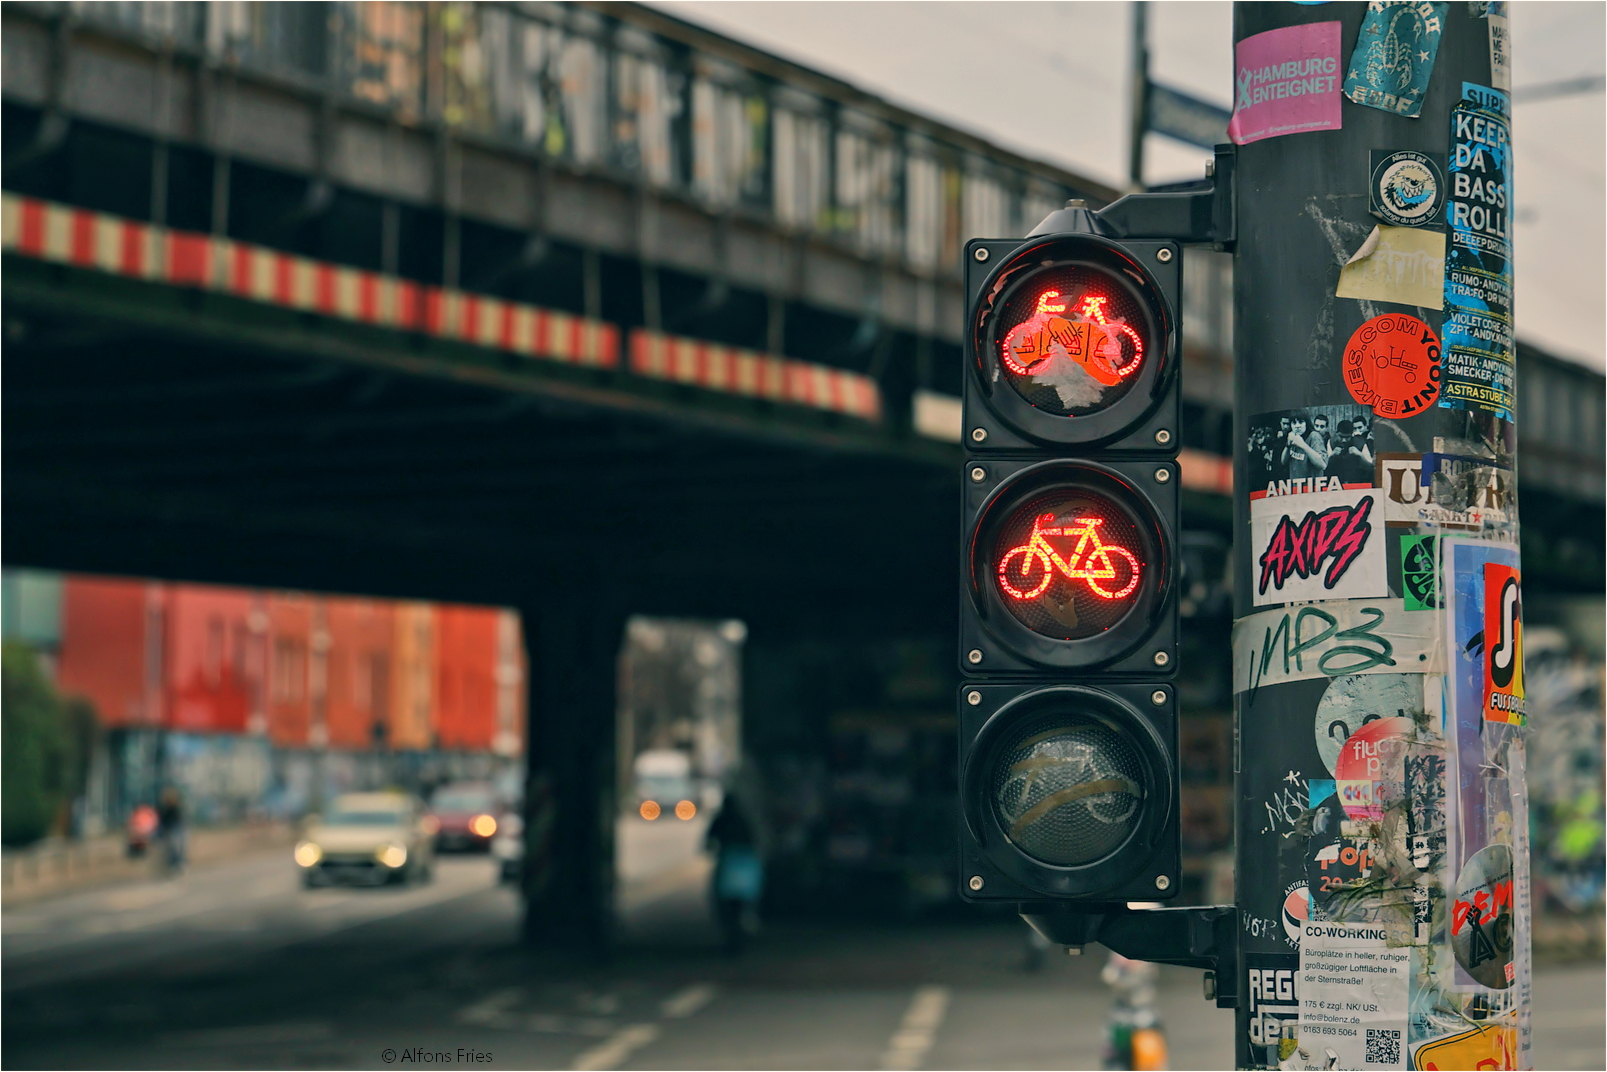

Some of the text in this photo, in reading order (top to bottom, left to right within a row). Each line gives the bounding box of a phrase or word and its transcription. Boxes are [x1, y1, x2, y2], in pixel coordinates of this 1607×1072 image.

[1253, 57, 1337, 86] HAMBURG
[1253, 76, 1337, 104] ENTEIGNET
[1456, 114, 1506, 149] KEEP
[1392, 152, 1427, 164] Alles ist gut
[1456, 142, 1486, 172] DA
[1454, 172, 1506, 208] BASS
[1380, 204, 1400, 221] solange
[1410, 216, 1426, 224] queer
[1452, 272, 1480, 286] RUMO
[1451, 312, 1482, 328] VIOLET
[1482, 319, 1500, 333] CORE
[1450, 324, 1470, 336] ZPT
[1448, 354, 1478, 368] MATIK
[1448, 364, 1492, 382] SMECKER
[1446, 384, 1479, 398] ASTRA
[1480, 389, 1503, 403] STUBE
[1266, 476, 1343, 498] ANTIFA
[1306, 926, 1386, 940] CO-WORKING
[1306, 948, 1344, 958] Büroplätze
[1354, 952, 1378, 960] heller,
[1380, 954, 1410, 962] ruhiger,
[1304, 962, 1348, 972] großzügiger
[1350, 964, 1388, 973] Loftfläche
[1318, 975, 1364, 985] Sternstraße!
[1327, 1002, 1344, 1010] zzgl.
[1346, 1002, 1361, 1010] NK/
[1362, 1004, 1380, 1012] USt.
[1304, 1013, 1360, 1024] info@bolenz.de
[1322, 1027, 1336, 1035] 693
